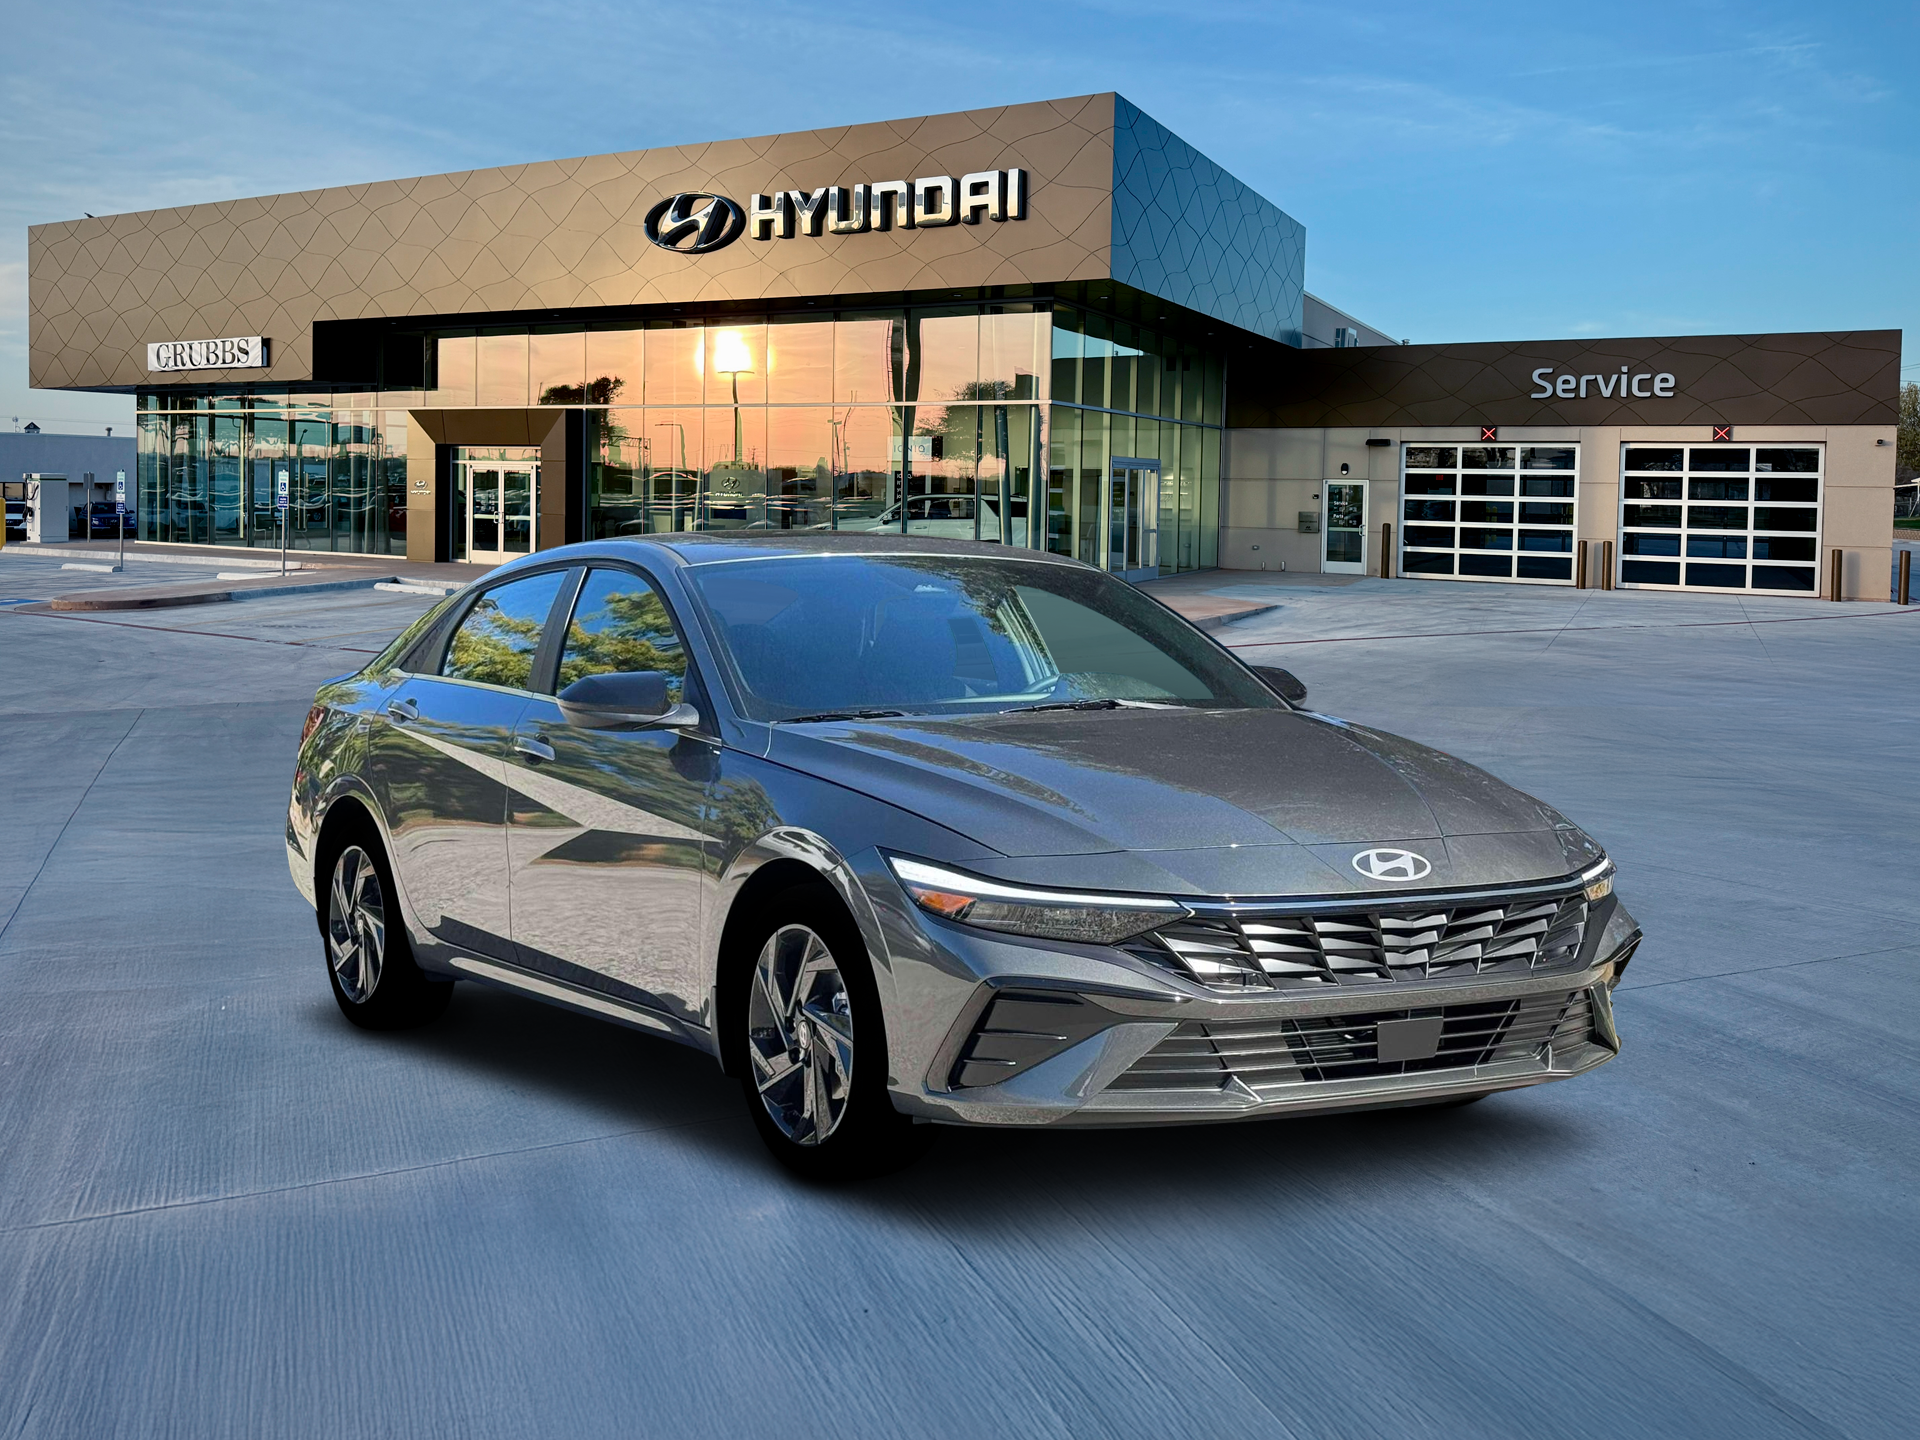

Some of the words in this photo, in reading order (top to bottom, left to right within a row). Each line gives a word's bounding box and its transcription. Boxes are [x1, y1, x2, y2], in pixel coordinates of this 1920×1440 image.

[750, 168, 1029, 240] HYUNDAI
[156, 338, 250, 369] GRUBBS
[1531, 365, 1676, 399] Service
